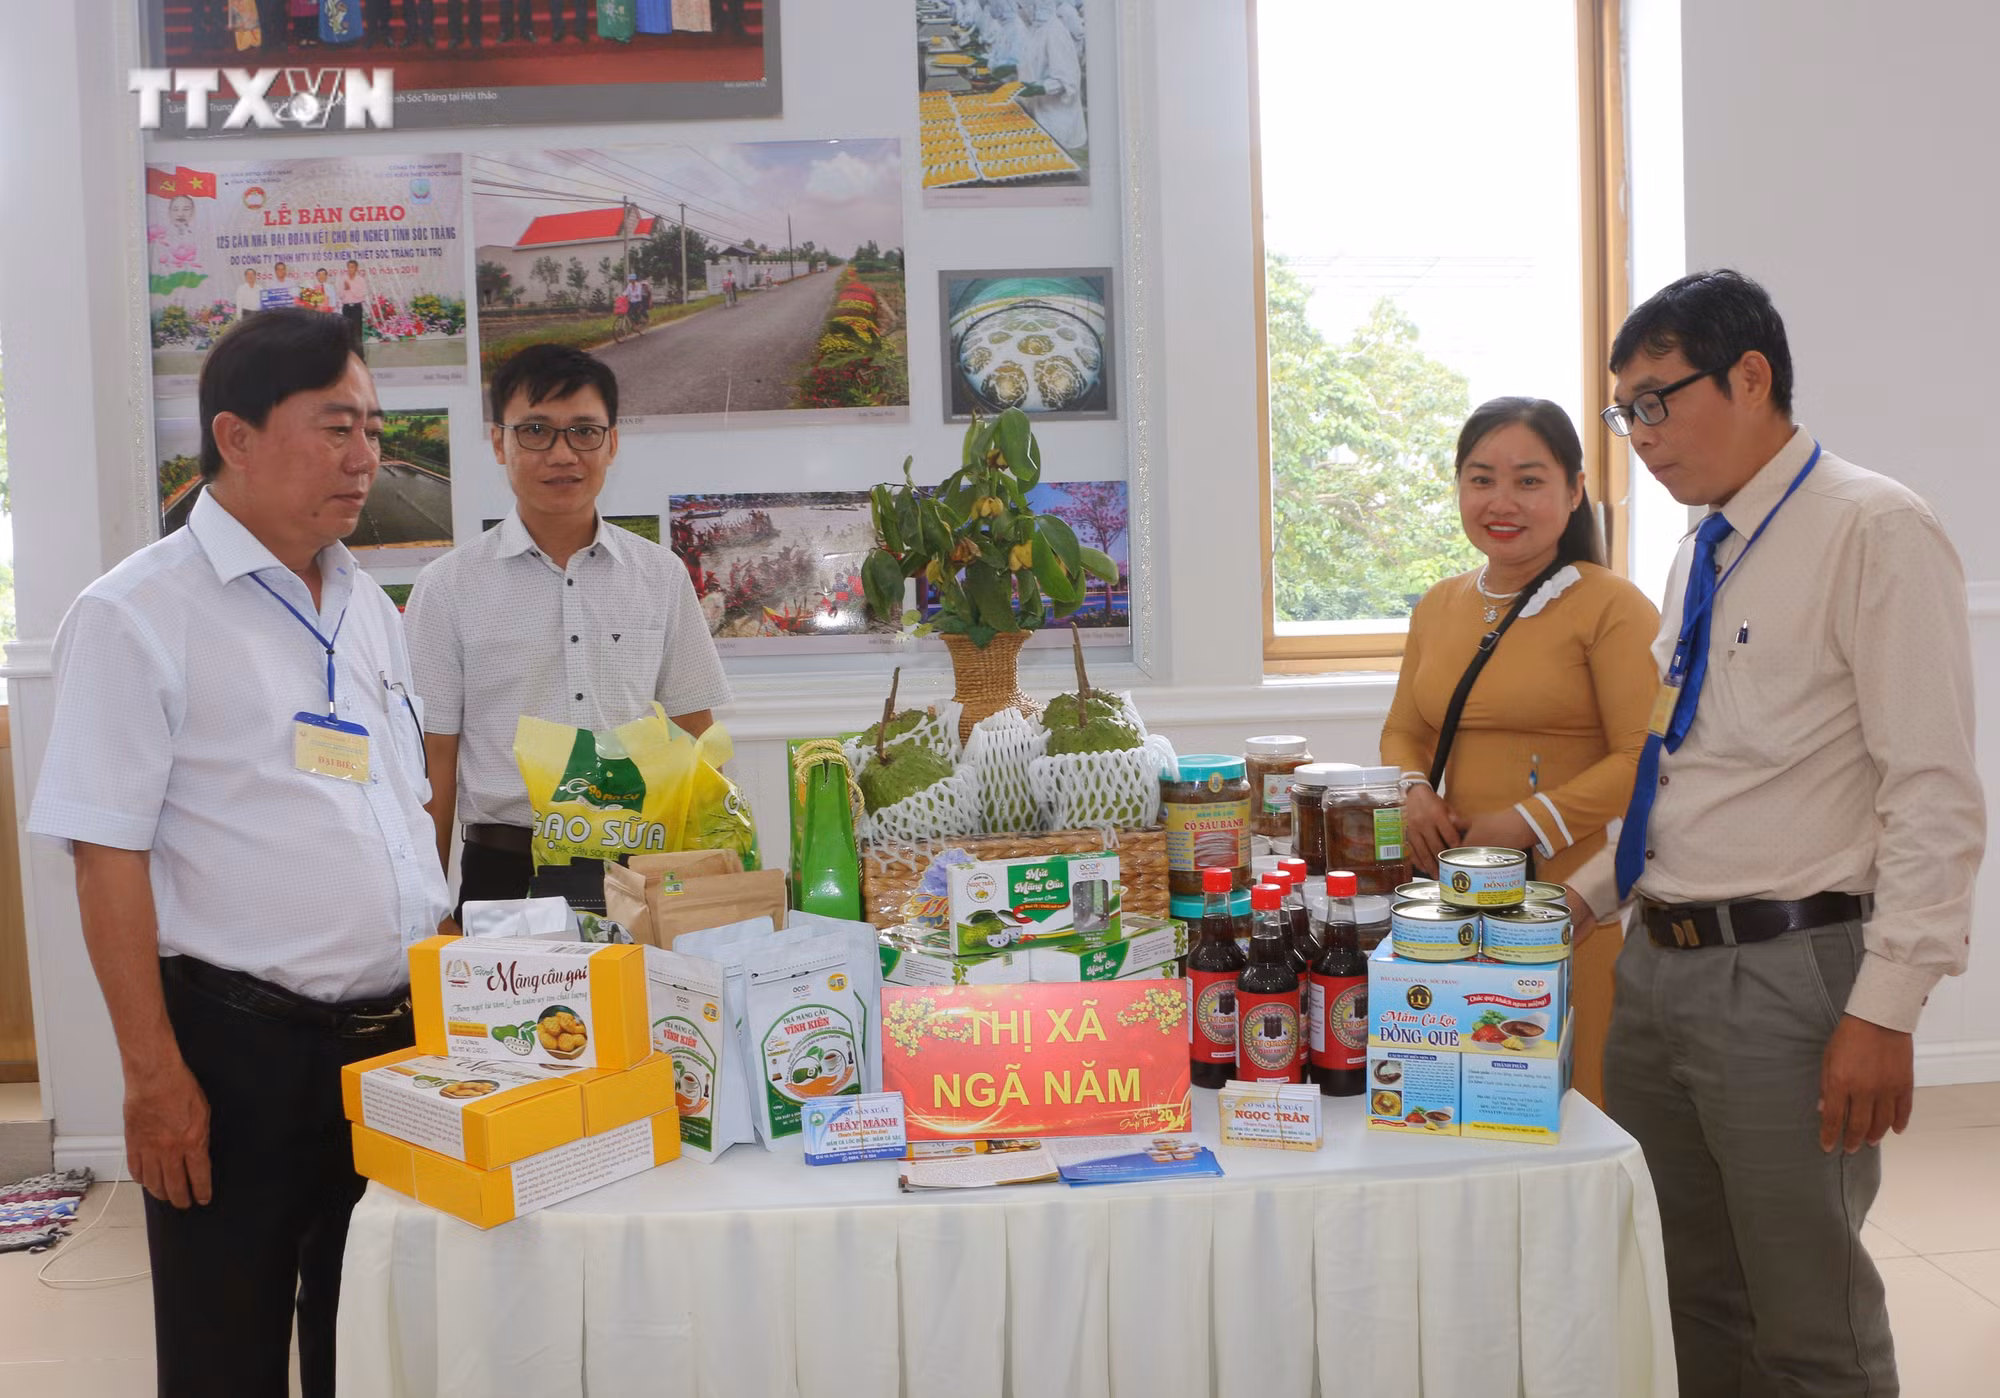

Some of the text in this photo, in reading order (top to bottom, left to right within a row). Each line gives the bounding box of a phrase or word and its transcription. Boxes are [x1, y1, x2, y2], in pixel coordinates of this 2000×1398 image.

[406, 90, 498, 104] Sóc Trăng tại Hội thảo
[263, 201, 406, 226] LỄ BÀN GIAO
[217, 236, 229, 248] 125
[332, 229, 347, 243] CHO
[230, 256, 240, 265] DO
[242, 253, 261, 264] CÔNG
[263, 254, 272, 264] TY
[601, 815, 667, 850] SỮA
[1025, 863, 1101, 881] Mứt OCOP
[1014, 878, 1064, 895] Mãng Cầu
[487, 961, 539, 996] Mãng
[542, 967, 563, 986] cầu
[564, 965, 588, 991] gai
[971, 999, 1107, 1053] THỊ XÃ
[1381, 1010, 1419, 1025] Mắm
[1421, 1013, 1436, 1027] Cá
[784, 1020, 807, 1036] VĨNH
[1380, 1023, 1460, 1046] ĐỒNG QUÊ
[933, 1060, 1141, 1108] NGÃ NĂM
[828, 1117, 860, 1132] THẦY
[1235, 1110, 1310, 1123] NGỌC TRÂN
